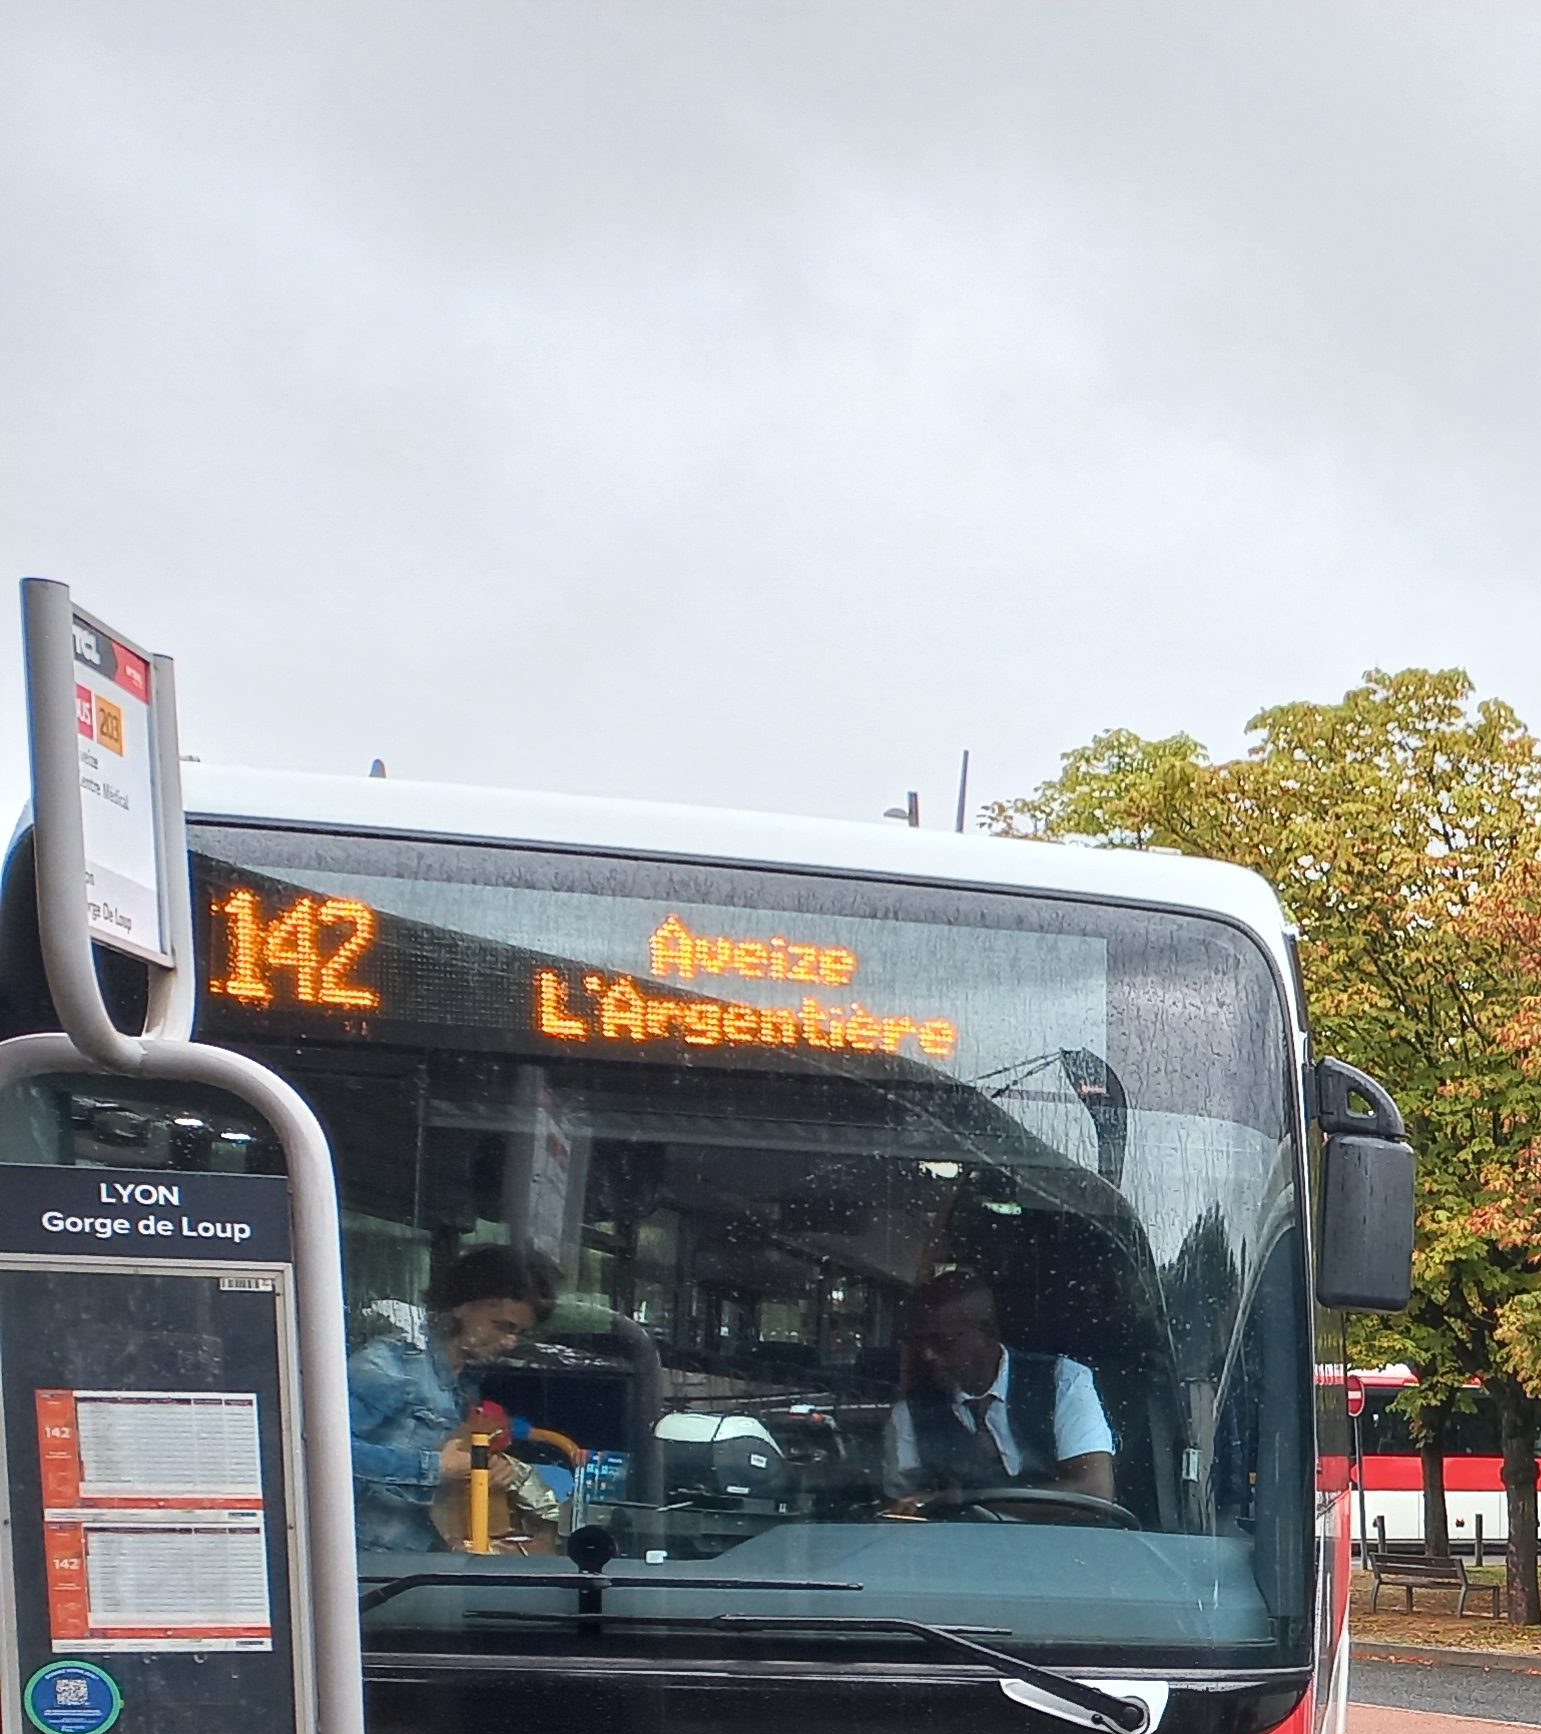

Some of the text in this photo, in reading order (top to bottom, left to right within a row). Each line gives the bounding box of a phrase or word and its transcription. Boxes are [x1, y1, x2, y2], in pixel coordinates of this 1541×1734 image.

[77, 698, 91, 725] US
[80, 777, 101, 796] entre
[209, 888, 379, 1008] 142
[648, 912, 860, 987] Aveize
[534, 968, 958, 1056] L'Argentière
[99, 1182, 182, 1206] LYON
[41, 1211, 252, 1243] Gorge de Loup
[45, 1426, 72, 1439] 142
[53, 1558, 80, 1570] 142
